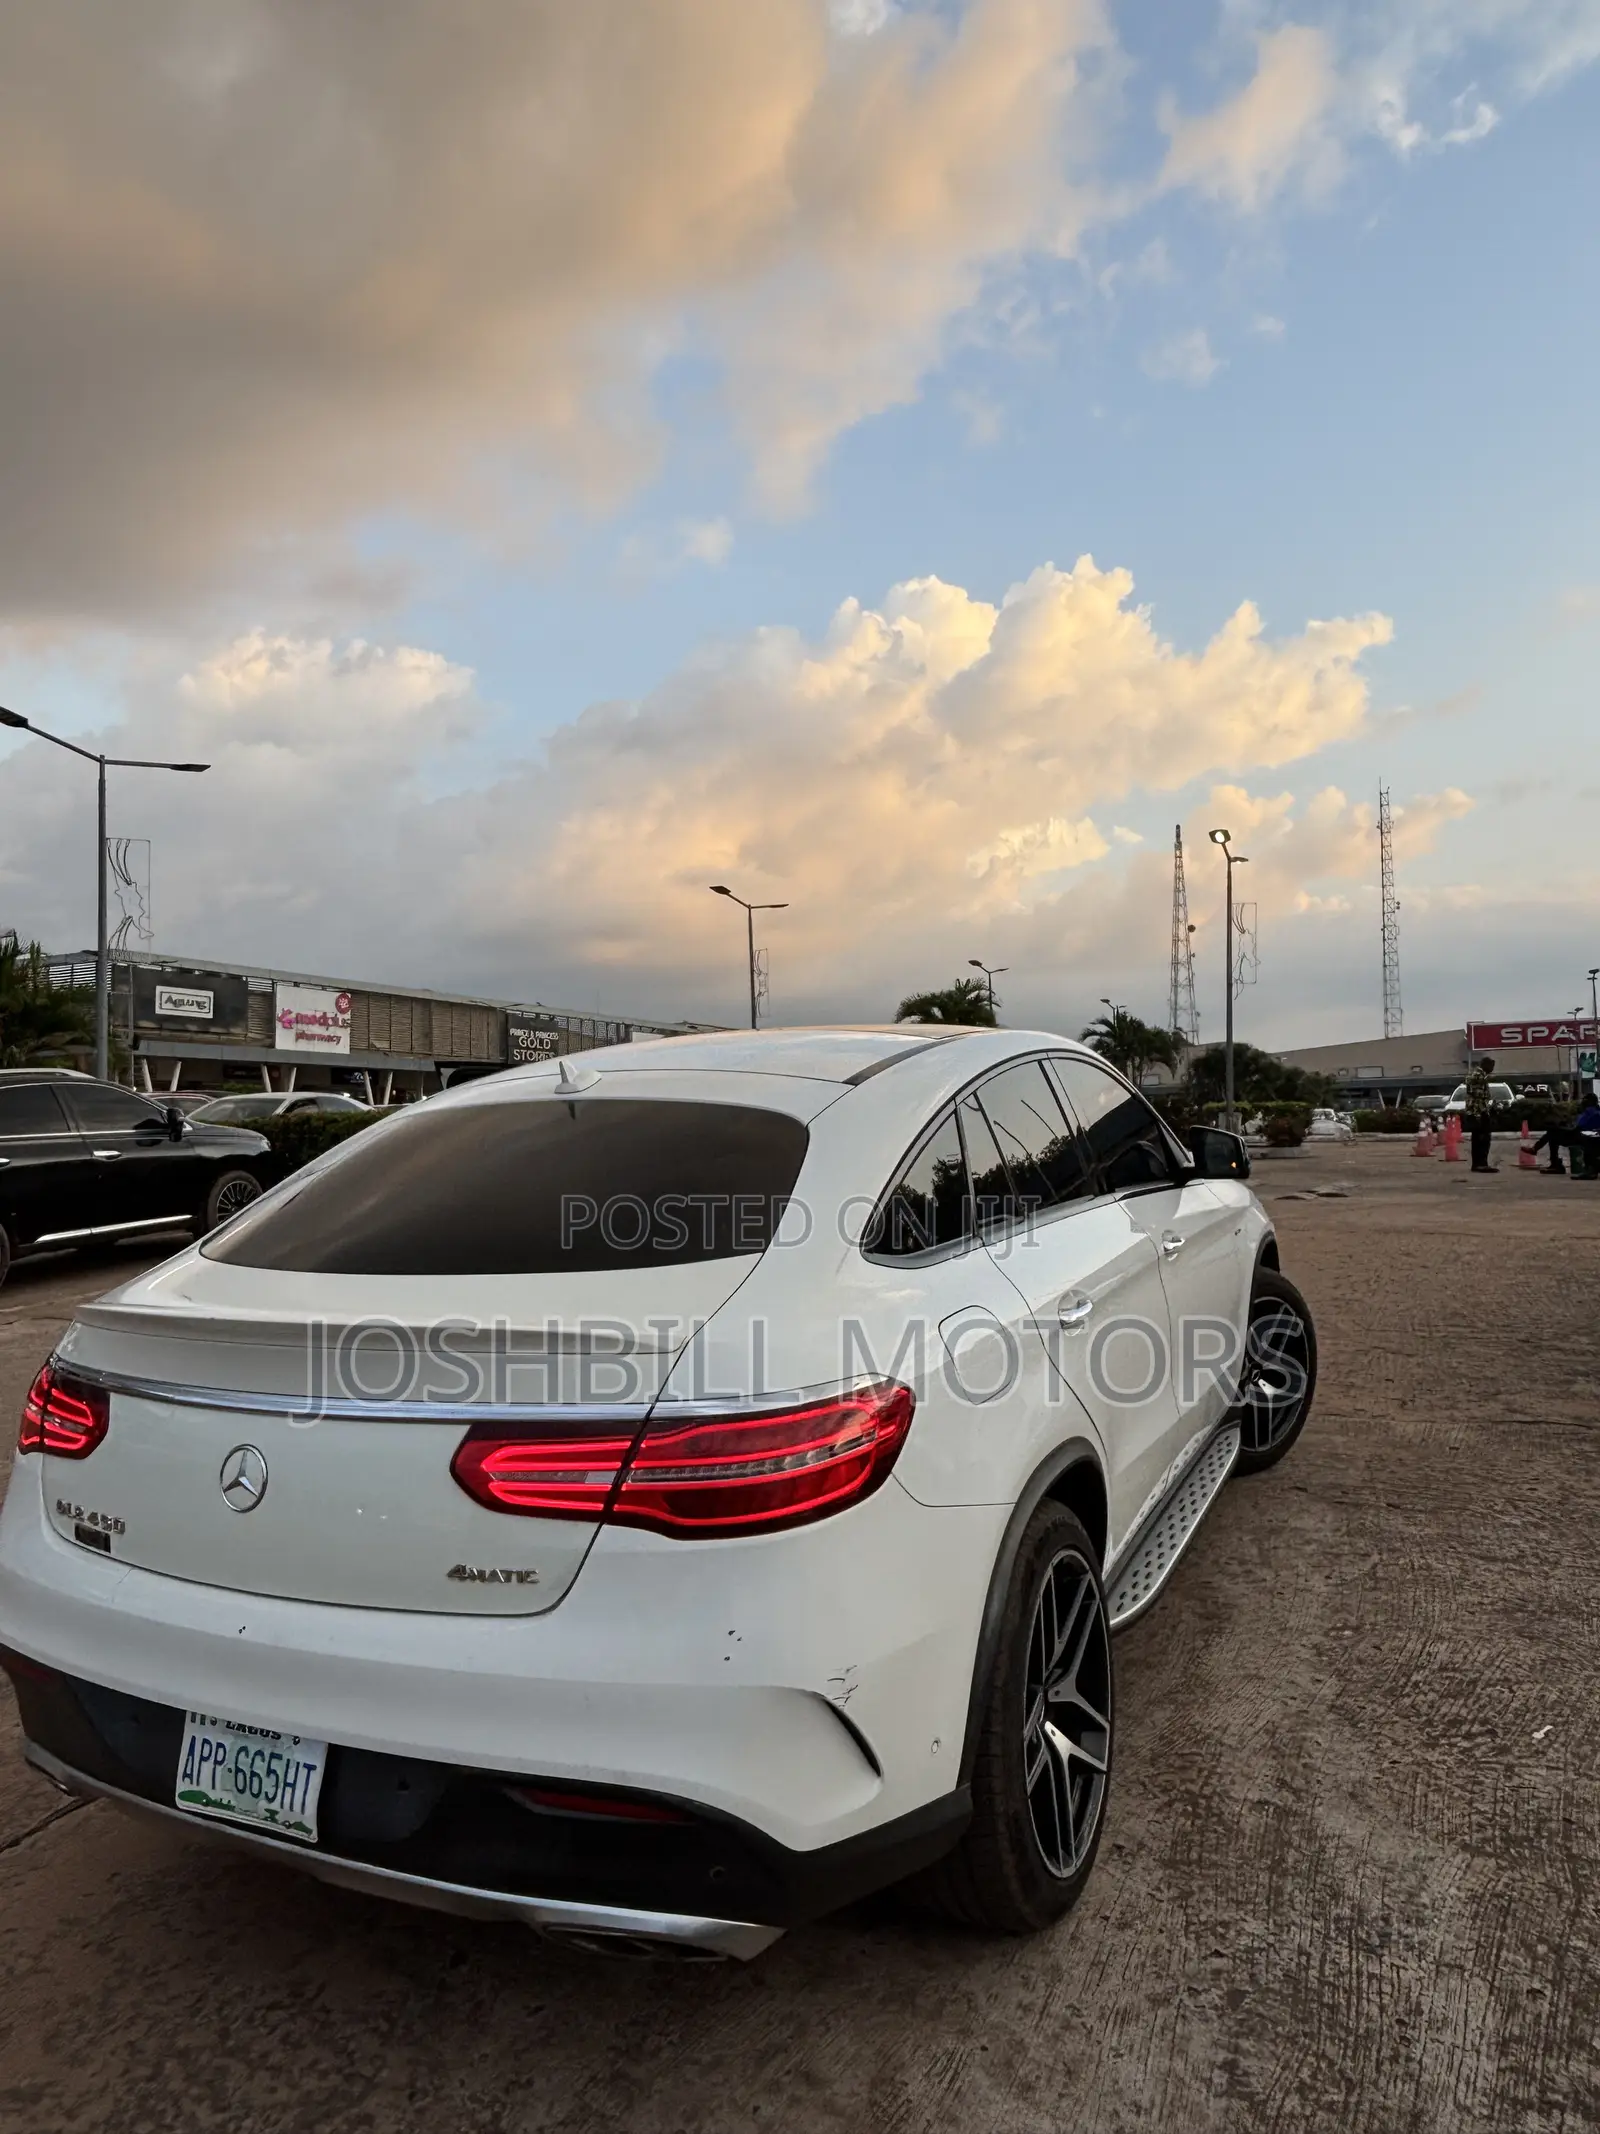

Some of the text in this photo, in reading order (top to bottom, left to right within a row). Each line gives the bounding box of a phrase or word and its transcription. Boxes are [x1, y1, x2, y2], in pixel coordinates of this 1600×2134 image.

[295, 1030, 341, 1045] pharmacy
[518, 1036, 551, 1049] GOLD
[446, 1563, 540, 1584] 4MATIC
